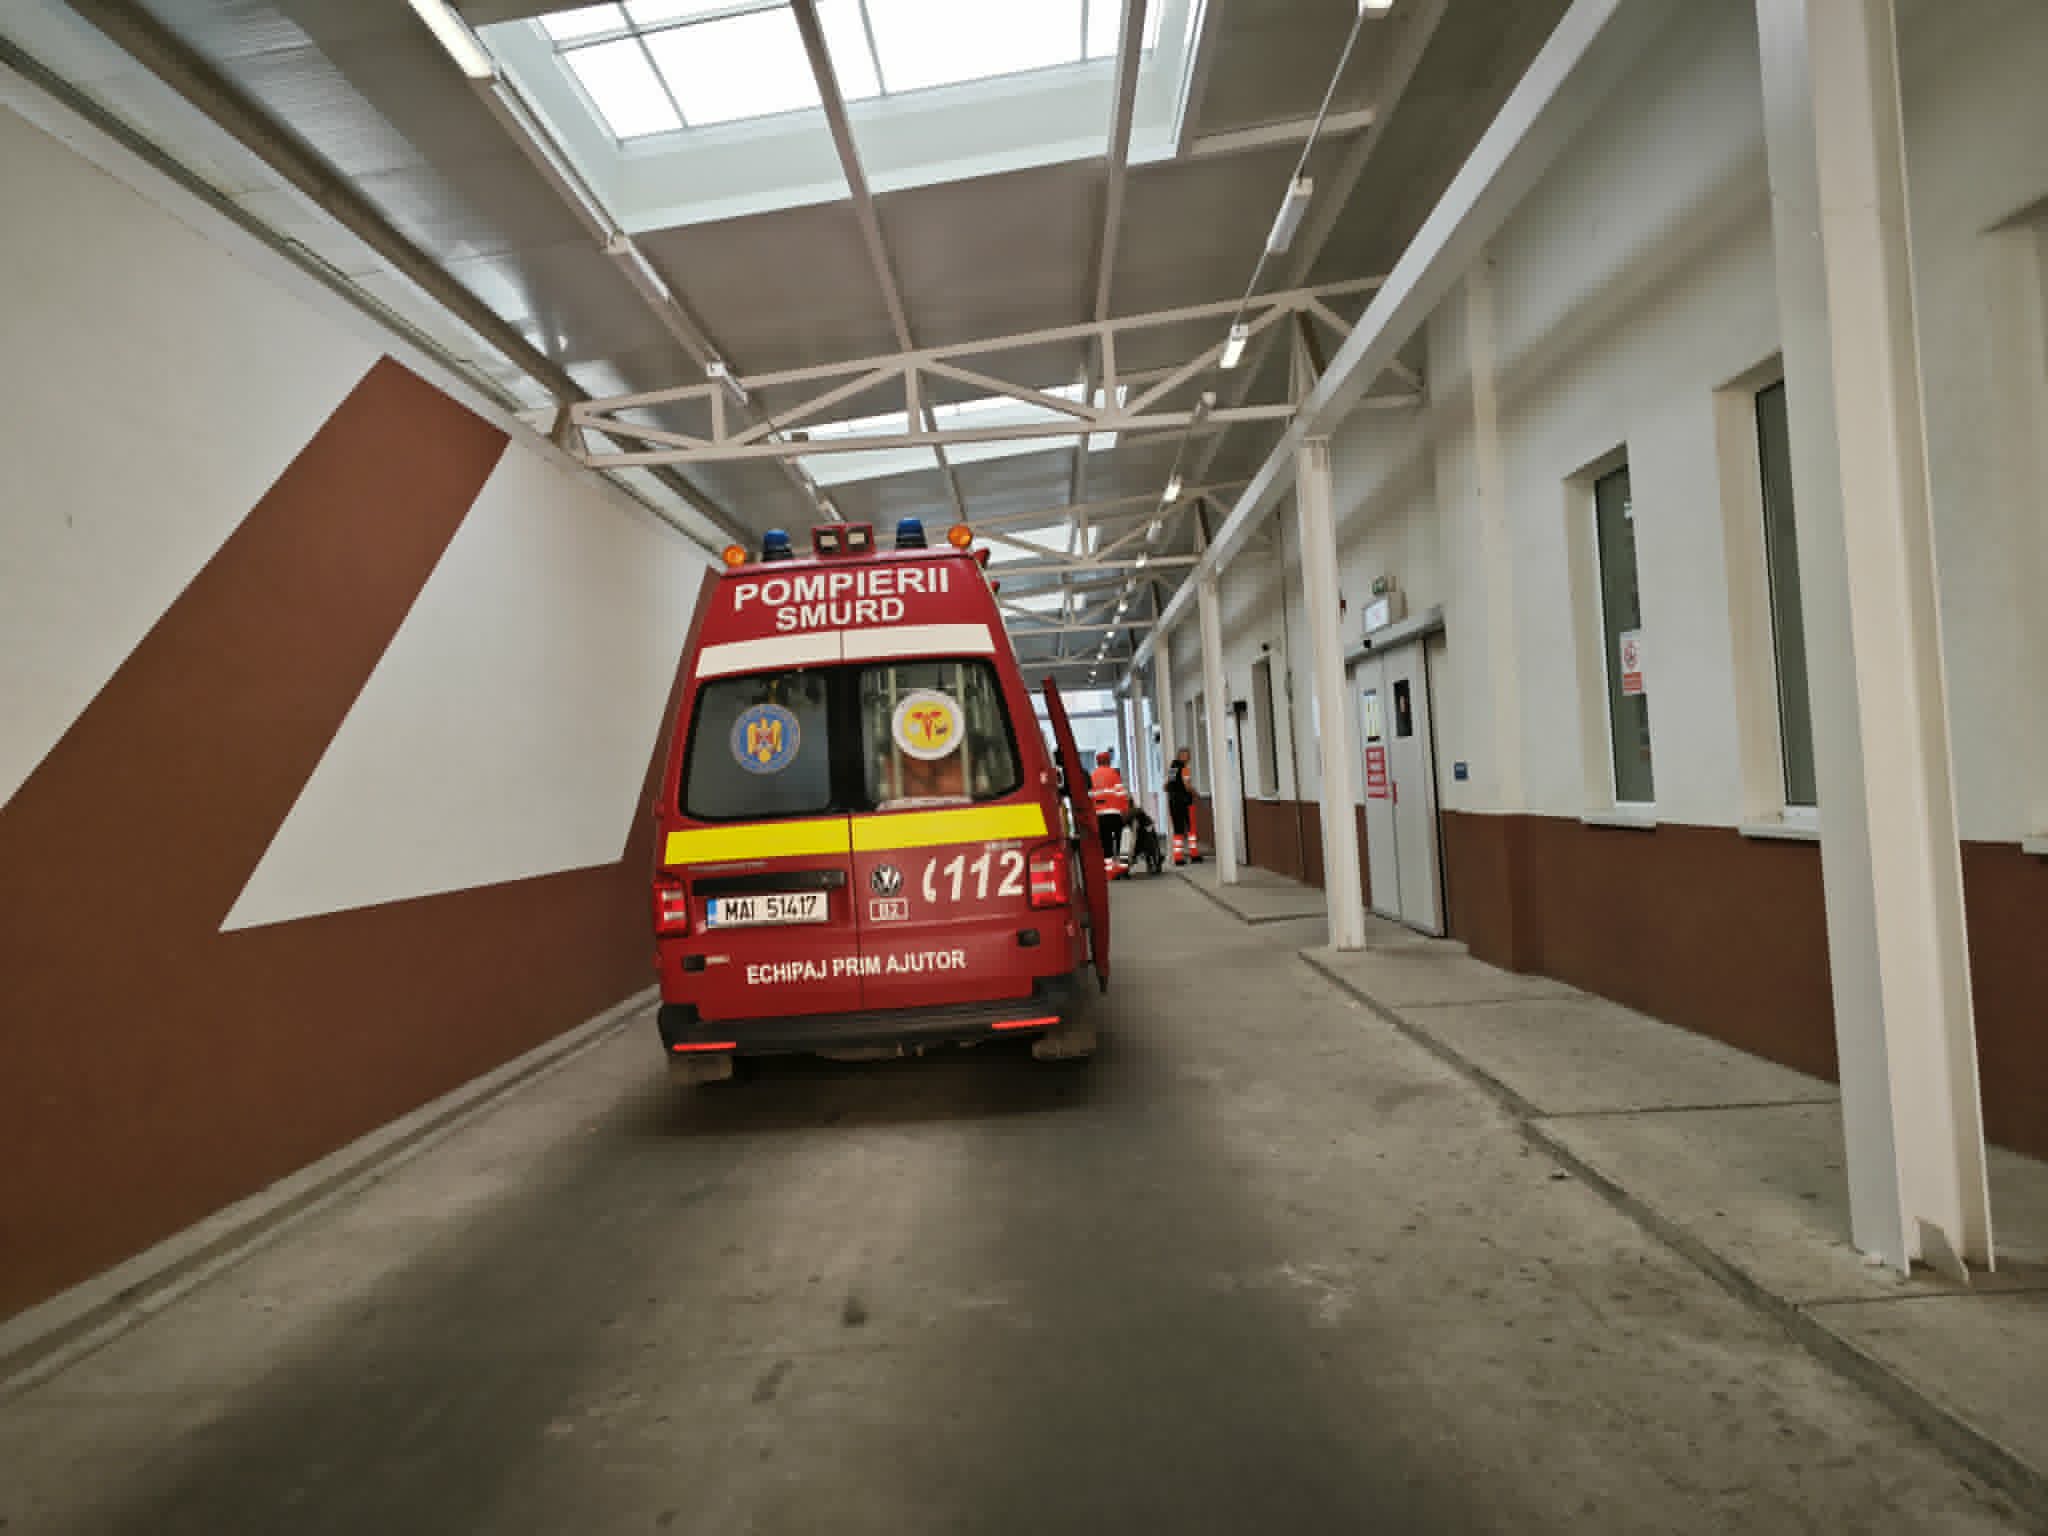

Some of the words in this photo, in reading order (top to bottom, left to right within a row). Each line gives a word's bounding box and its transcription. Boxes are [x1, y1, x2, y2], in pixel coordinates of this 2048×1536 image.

[734, 567, 949, 612] POMPIERII
[775, 597, 905, 631] SMURD
[943, 850, 1025, 902] 112
[726, 898, 754, 921] MAI
[767, 895, 817, 919] 51417
[746, 958, 828, 985] ECHIPAJ
[832, 954, 881, 978] PRIM
[886, 949, 967, 974] AJUTOR
